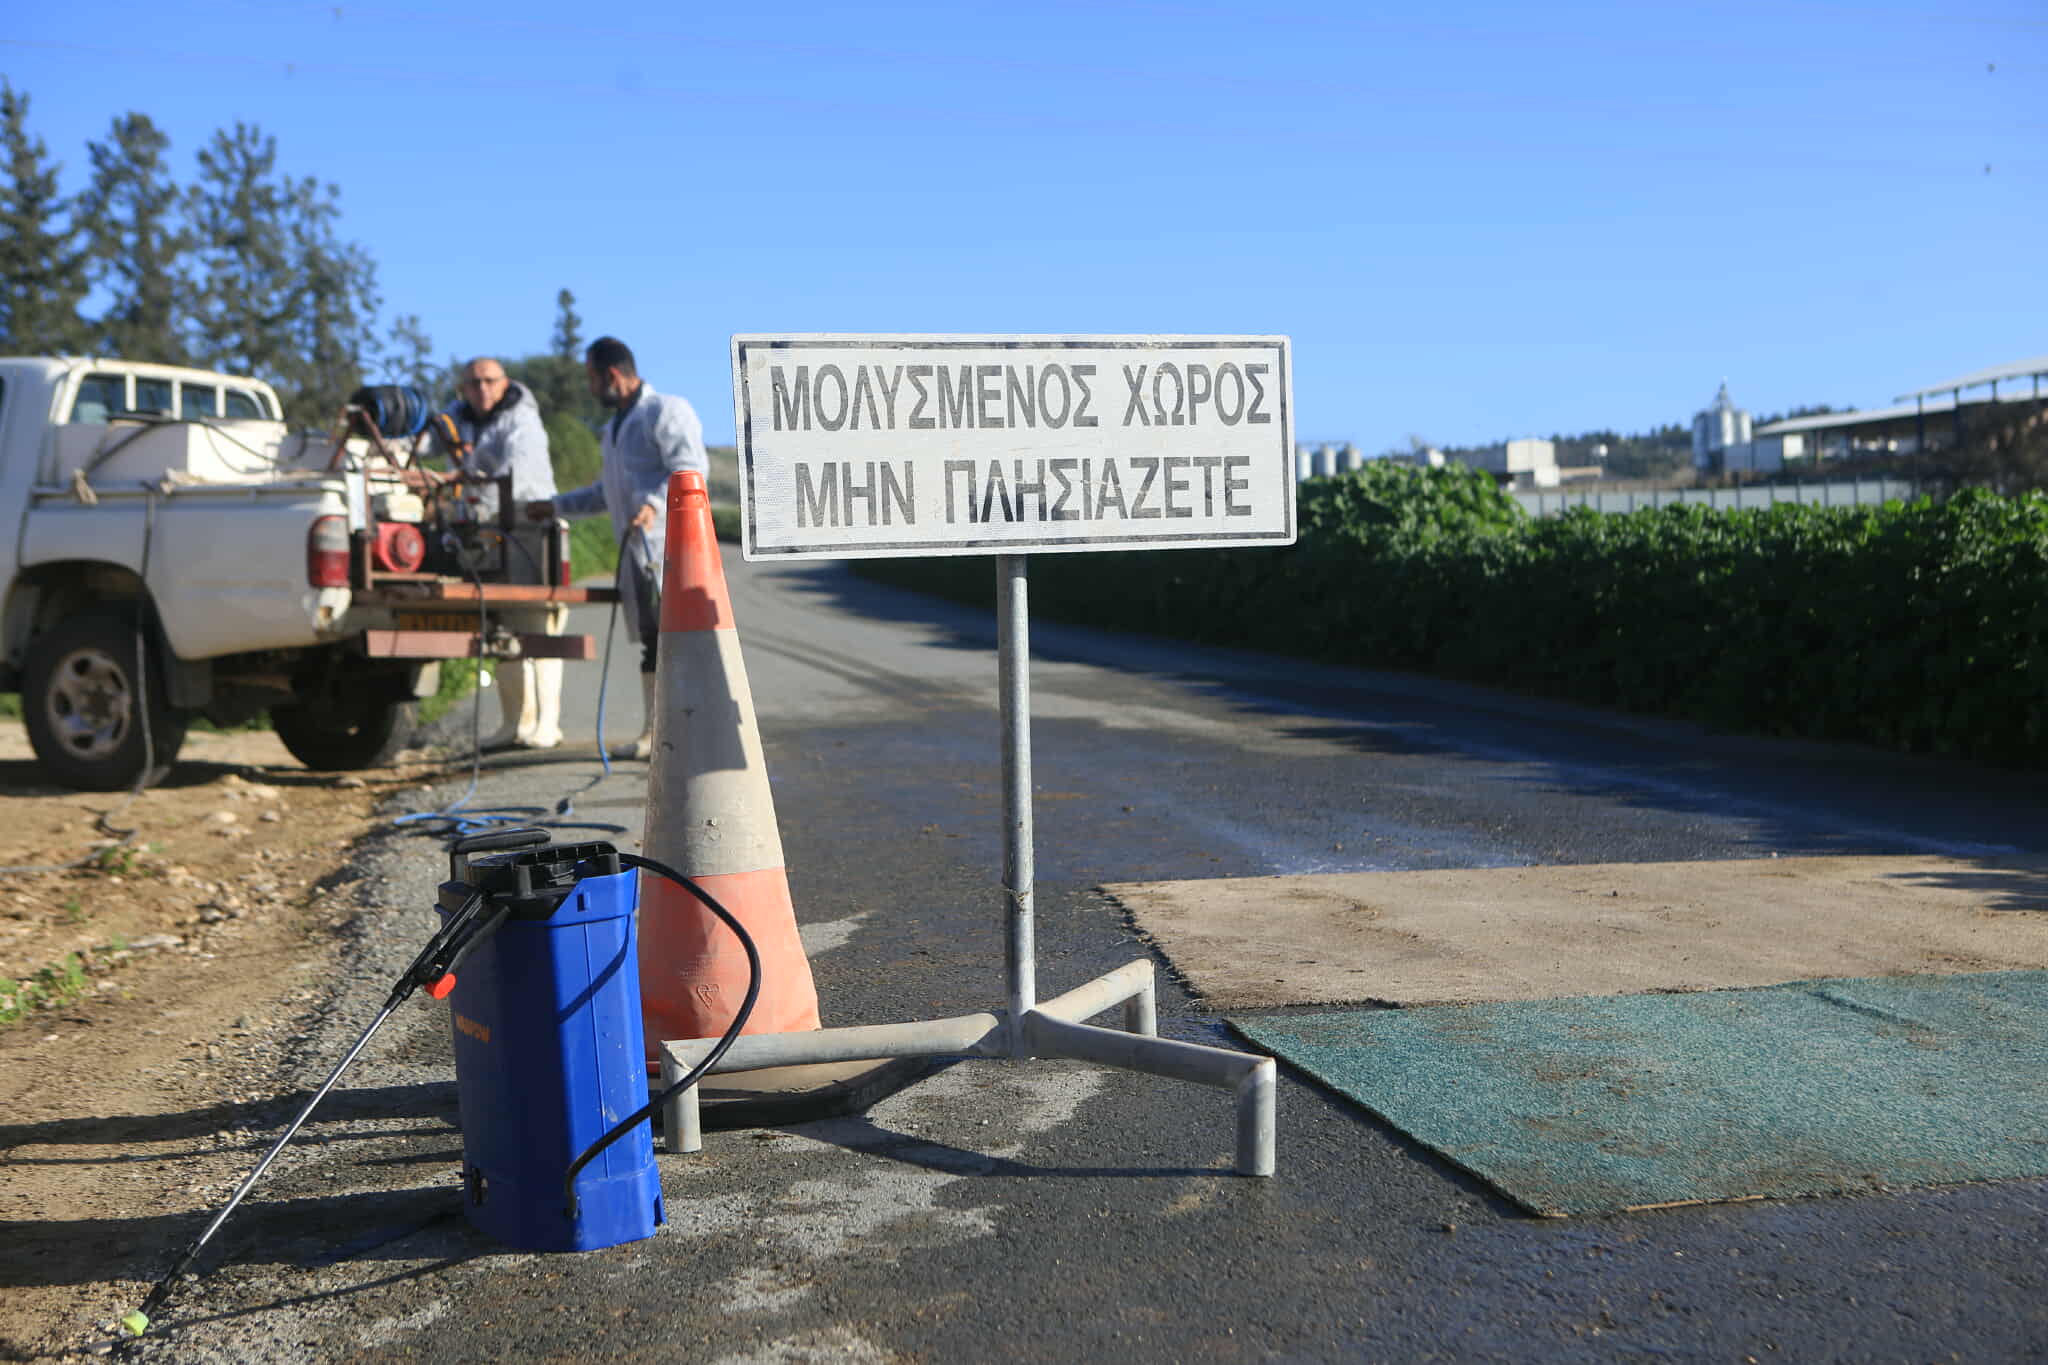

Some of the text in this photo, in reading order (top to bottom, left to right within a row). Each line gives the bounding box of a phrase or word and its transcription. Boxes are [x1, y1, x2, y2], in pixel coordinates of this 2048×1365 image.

[770, 361, 1272, 432] ΜΟΛΥΣΜΕΝΟΣ ΧΩΡΟΣ
[795, 455, 1253, 527] ΜΗΝ ΠΛΗΣΙΑΖΕΤΕ
